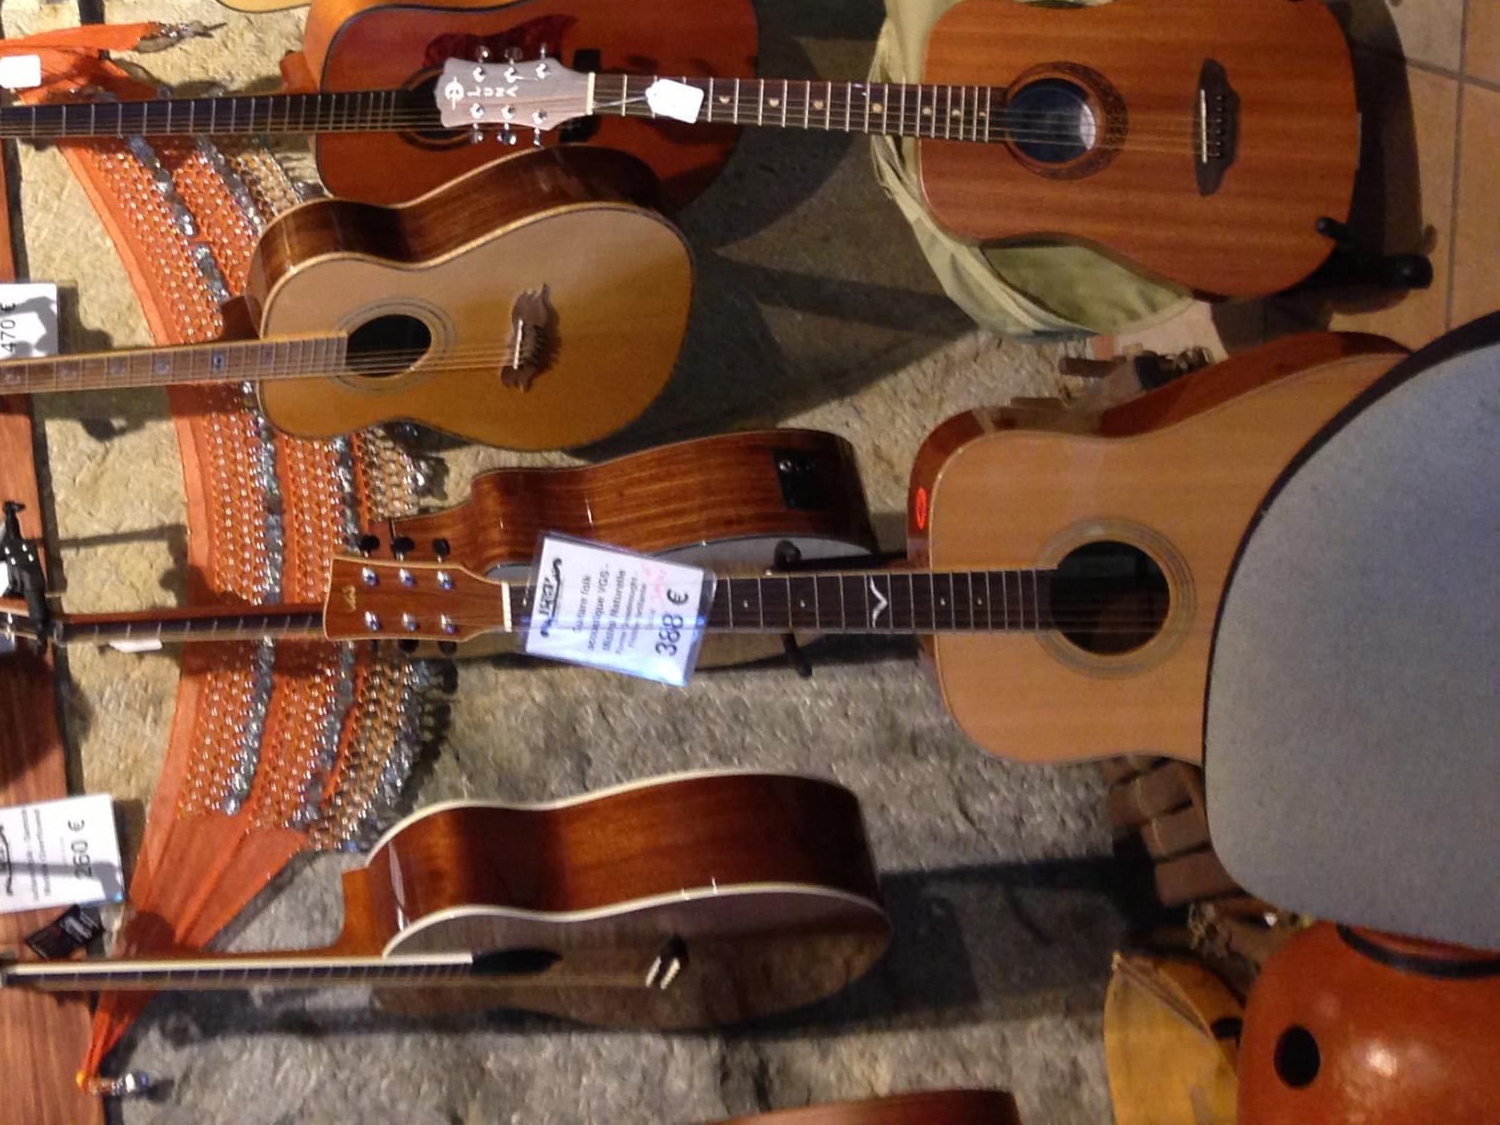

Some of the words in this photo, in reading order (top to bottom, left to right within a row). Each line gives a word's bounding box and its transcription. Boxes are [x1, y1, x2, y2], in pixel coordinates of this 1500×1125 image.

[466, 85, 518, 98] LUNA
[0, 302, 17, 314] €
[0, 319, 17, 353] 470
[665, 588, 689, 606] €
[654, 613, 684, 656] 388
[67, 819, 85, 832] €
[70, 841, 93, 880] 260
